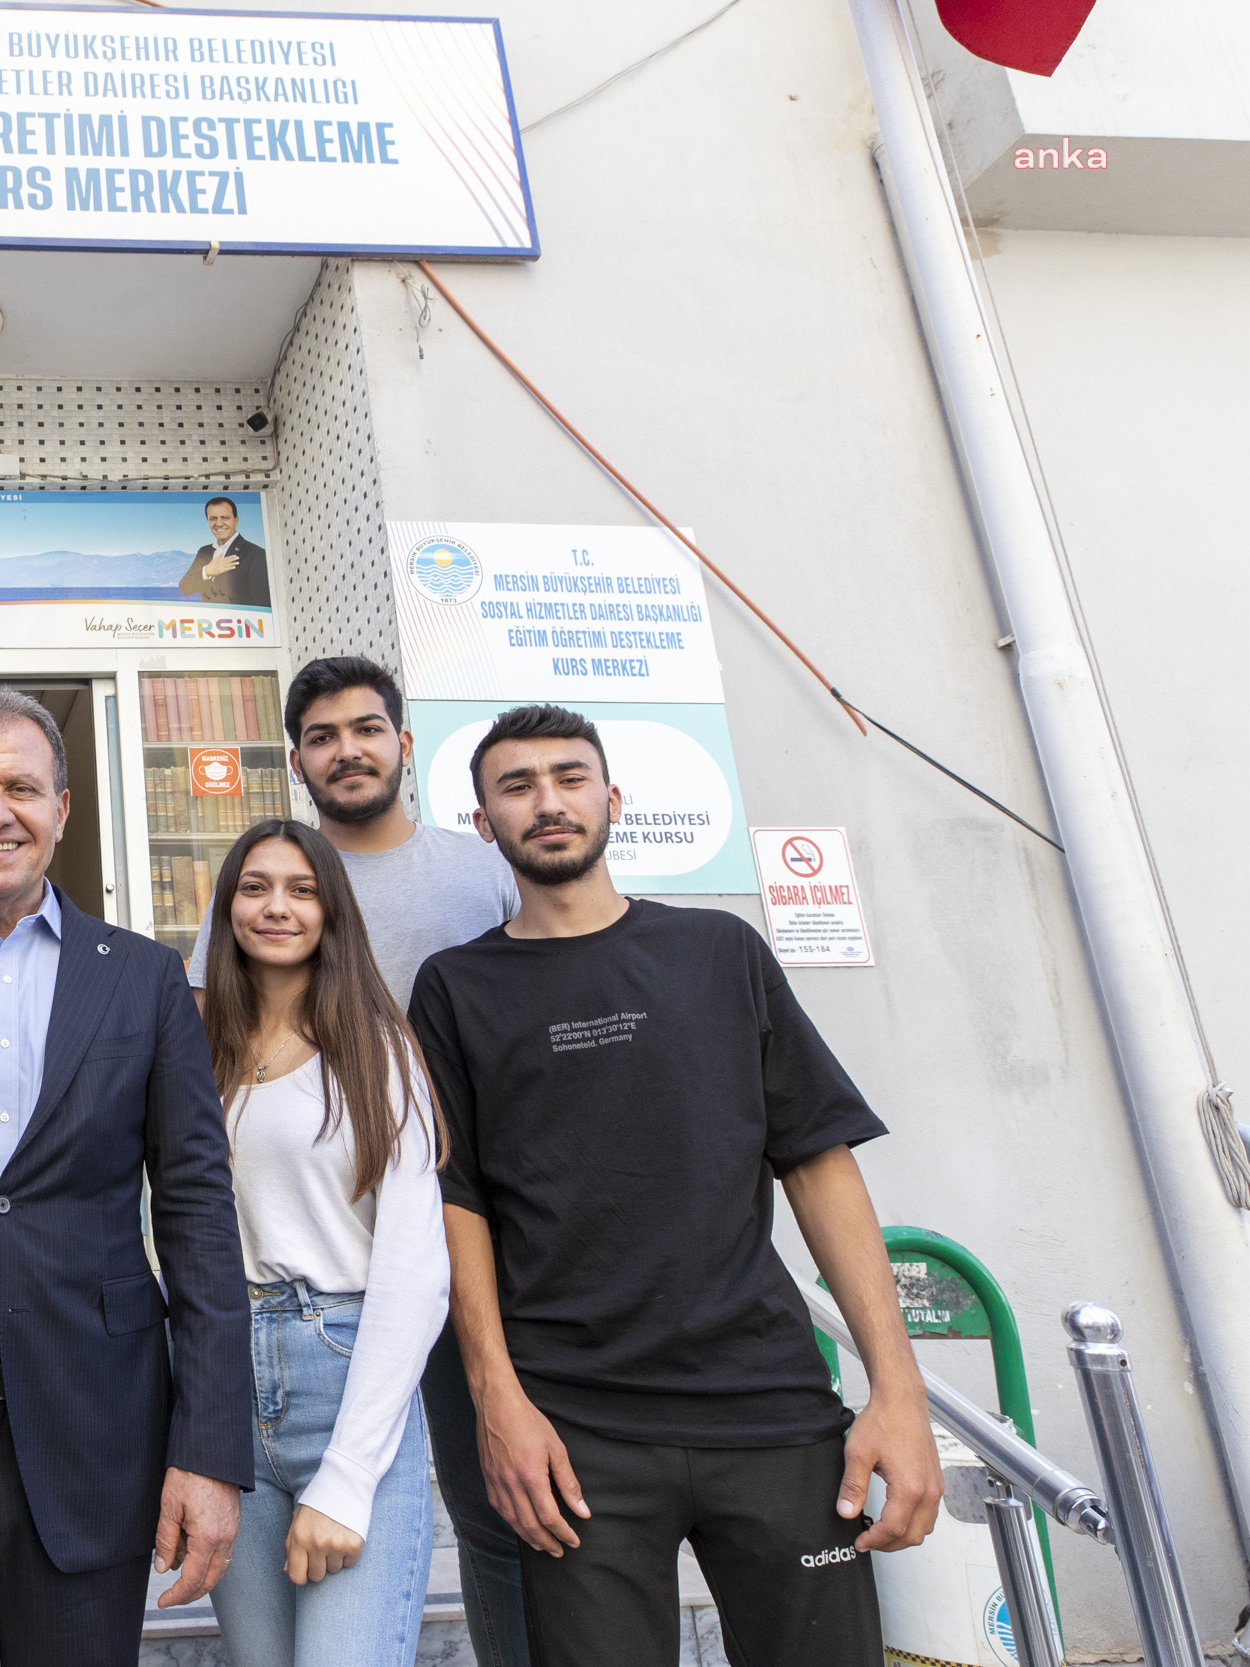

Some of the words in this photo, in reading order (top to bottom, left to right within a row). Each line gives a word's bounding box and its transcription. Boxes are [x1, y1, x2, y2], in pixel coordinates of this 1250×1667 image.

[8, 29, 179, 63] BÜYÜKŞEHİR
[189, 37, 337, 67] BELEDİYESİ
[84, 70, 190, 100] DAİRESİ
[200, 75, 359, 105] BAŞKANLIĞI
[141, 115, 399, 165] DESTEKLEME
[65, 166, 248, 215] MERKEZİ
[571, 549, 594, 566] T.C.
[493, 571, 540, 592] MERSİN
[542, 571, 614, 595] BÜYÜKŞEHİR
[616, 573, 681, 595] BELEDİYESİ
[480, 601, 523, 619] SOSYAL
[525, 598, 587, 620] HİZMETLER
[589, 600, 634, 621] DAİRESİ
[636, 601, 702, 624] BAŞKANLIĞI
[84, 616, 122, 638] Vahap
[124, 617, 156, 633] Seçer
[508, 625, 549, 648] EĞİTİM
[551, 626, 608, 649] ÖĞRETİMİ
[610, 630, 684, 650] DESTEKLEME
[552, 658, 588, 676] KURS
[591, 655, 650, 677] MERKEZİ
[624, 811, 710, 826] BELEDİYESİ
[642, 831, 694, 844] KURSU
[605, 848, 637, 861] UBESİ
[768, 881, 809, 906] SİGARA
[809, 881, 853, 909] İÇİLMEZ
[798, 945, 831, 953] 155-184
[548, 1023, 571, 1034] (BER)
[571, 1013, 619, 1029] International
[620, 1011, 648, 1021] Airport
[599, 1033, 633, 1046] Germany
[800, 1545, 856, 1568] adidas
[989, 1601, 999, 1635] MERSİN
